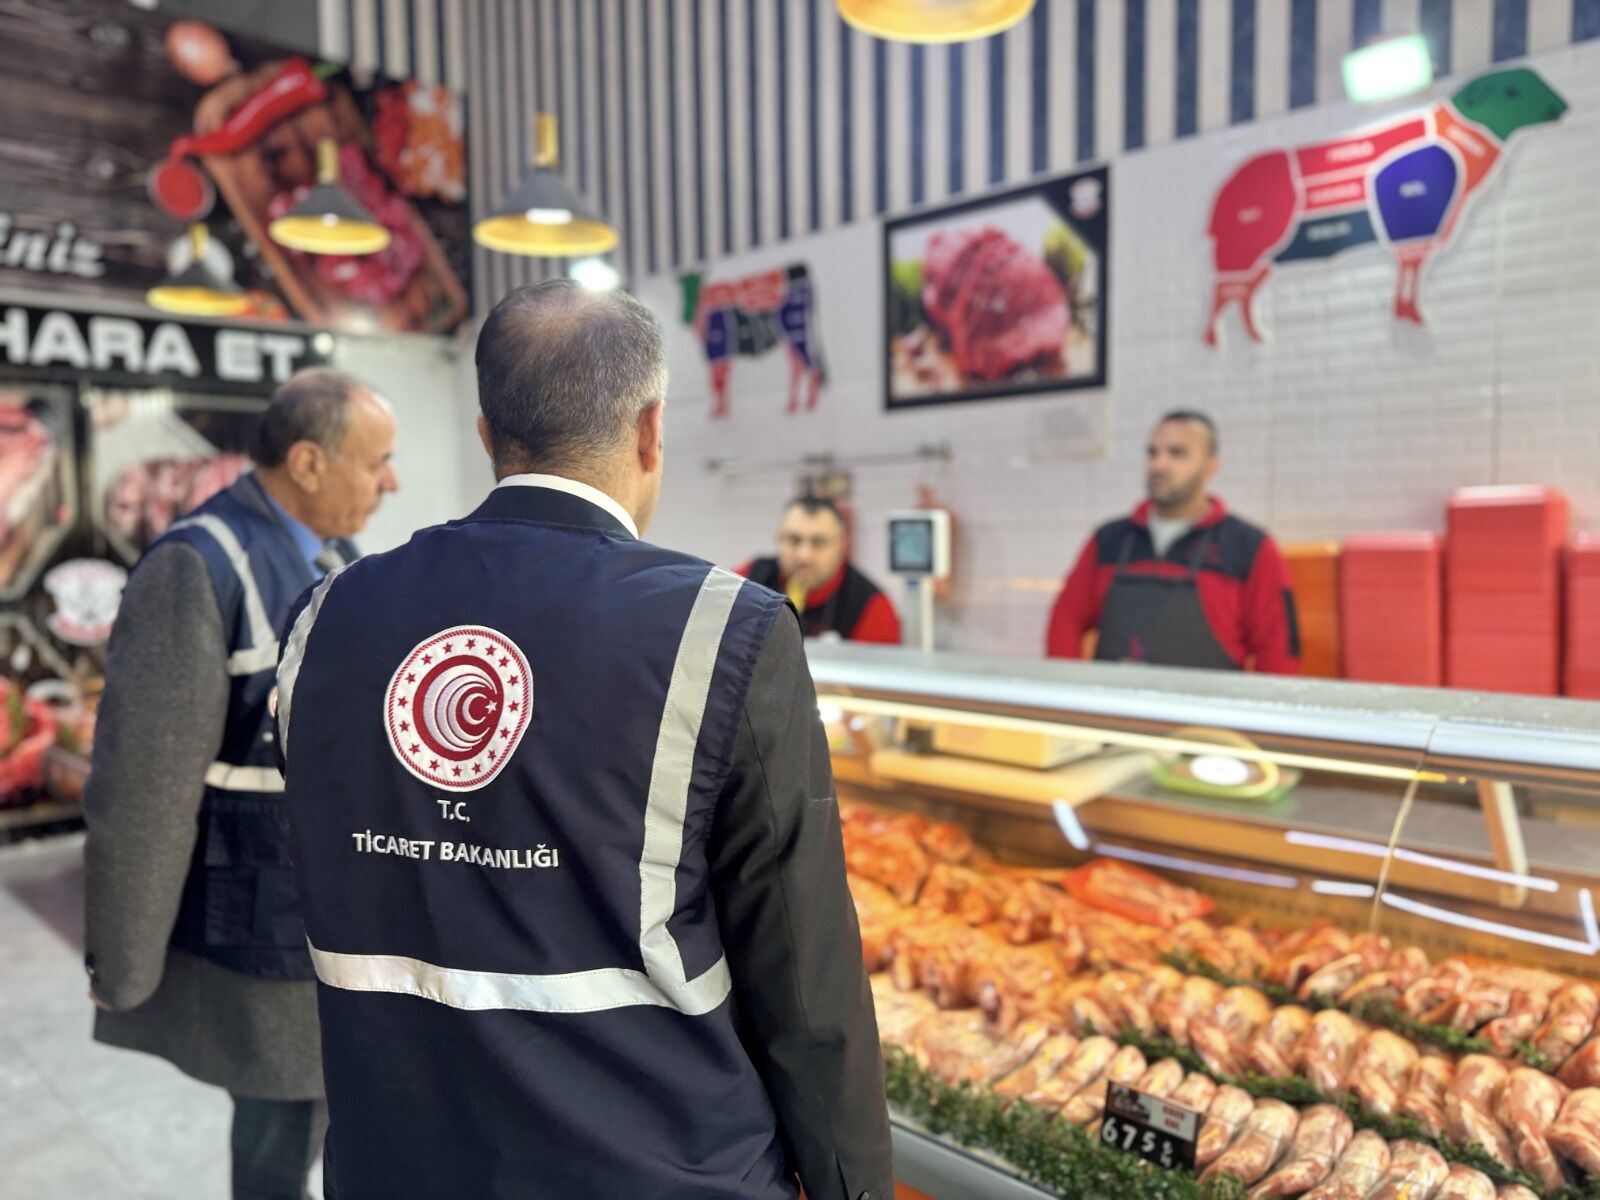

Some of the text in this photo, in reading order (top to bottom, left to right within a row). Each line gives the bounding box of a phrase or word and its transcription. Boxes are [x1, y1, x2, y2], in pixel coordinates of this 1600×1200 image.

[214, 329, 305, 383] ET
[437, 799, 471, 823] T.C.
[352, 829, 560, 869] TİCARET BAKANLIĞI
